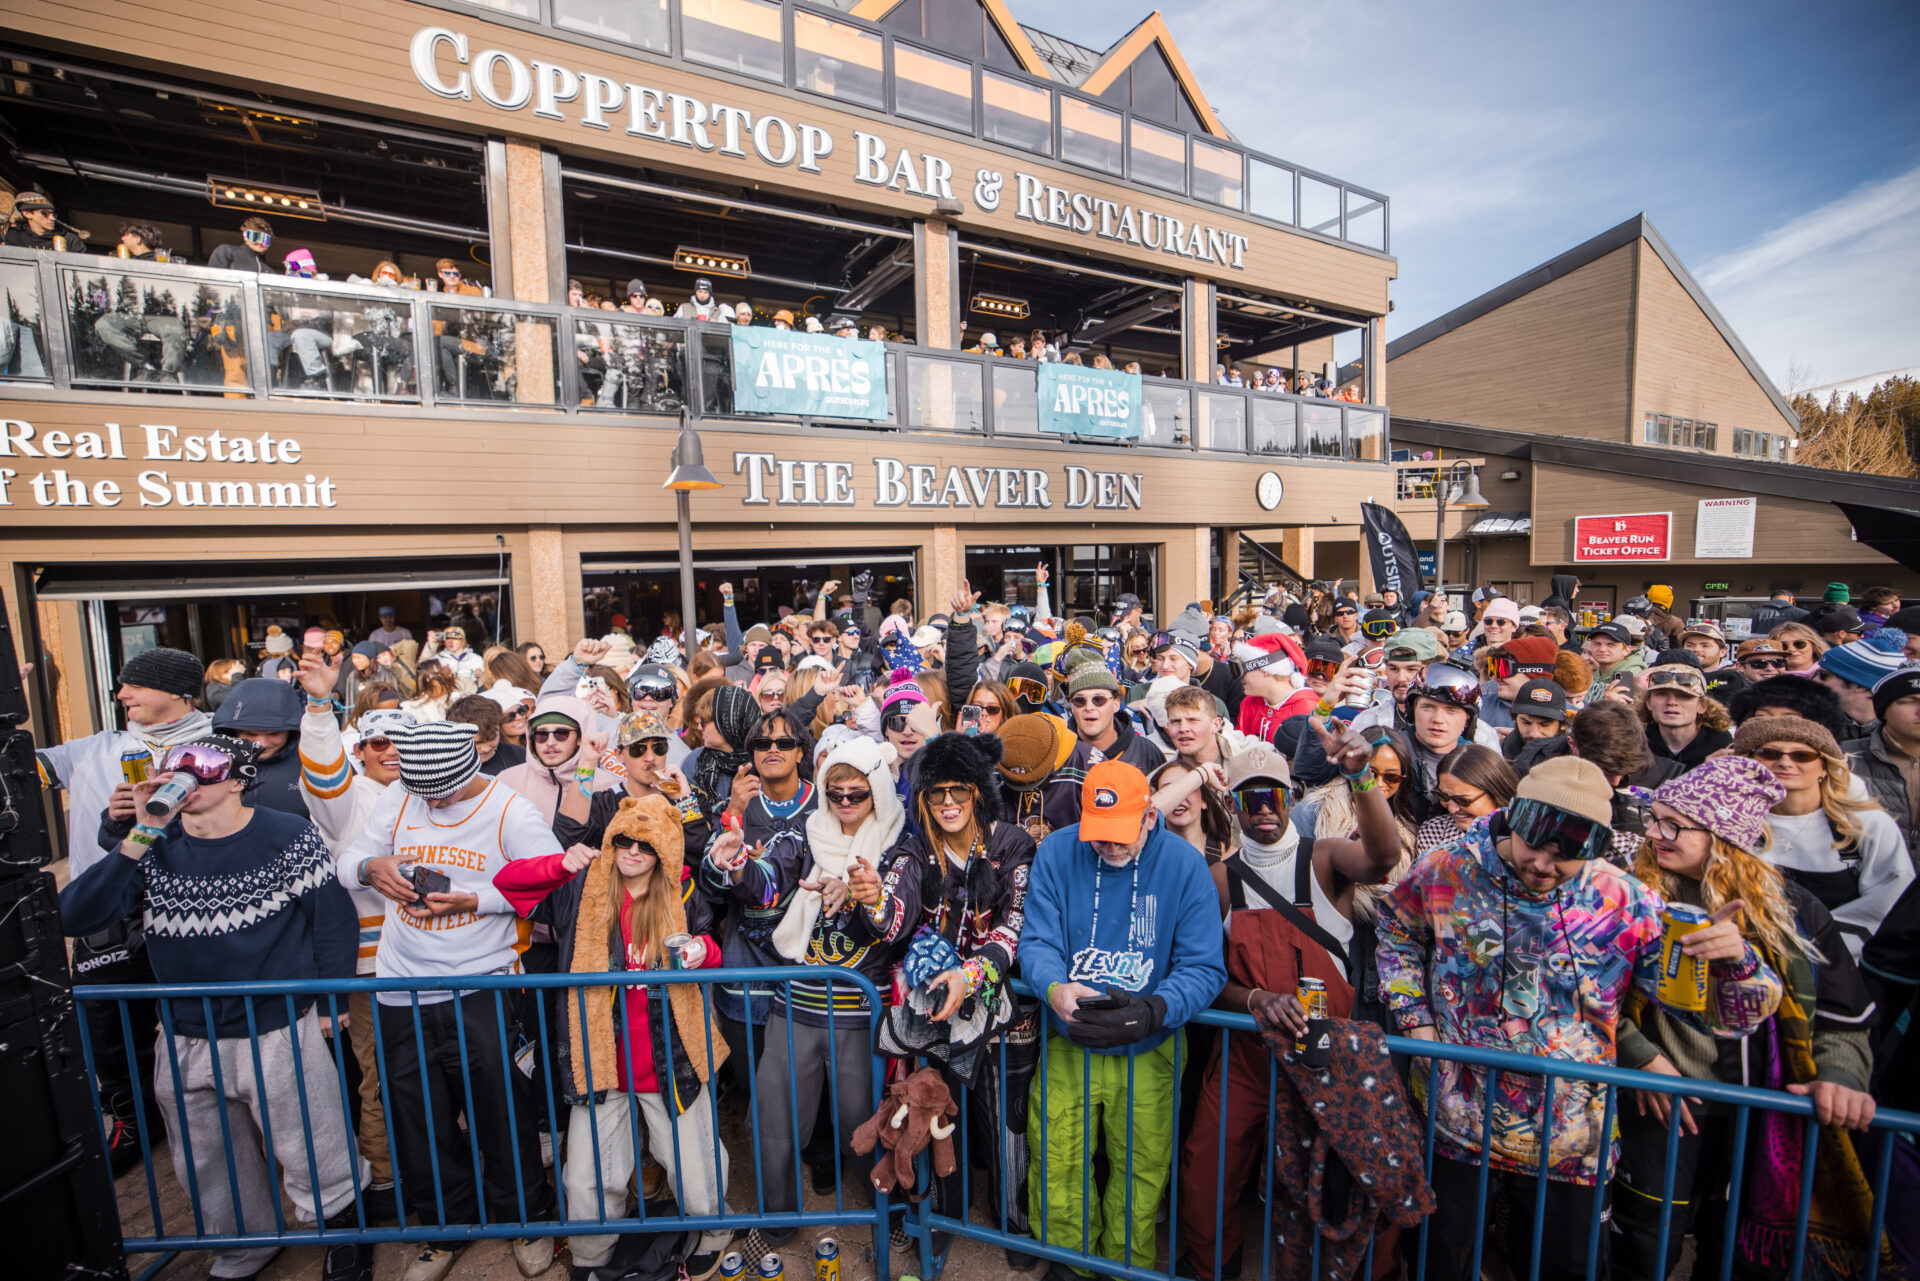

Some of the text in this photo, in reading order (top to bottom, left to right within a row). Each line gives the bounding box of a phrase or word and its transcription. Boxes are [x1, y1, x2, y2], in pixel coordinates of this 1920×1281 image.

[410, 26, 1249, 269] COPPERTOP BAR & RESTAURANT
[763, 339, 832, 354] HERE FOR THE
[755, 348, 872, 395] APRÈS
[1058, 373, 1105, 386] HERE FOR THE
[1053, 380, 1130, 419] APRÈS
[0, 419, 302, 464] Real Estate
[0, 468, 336, 508] f the Summit
[733, 451, 1144, 510] THE BEAVER DEN
[1582, 546, 1660, 555] TICKET OFFICE
[1589, 535, 1654, 544] BEAVER RUN
[400, 845, 487, 872] TENNESSEE
[1695, 959, 1706, 999] TWISTE
